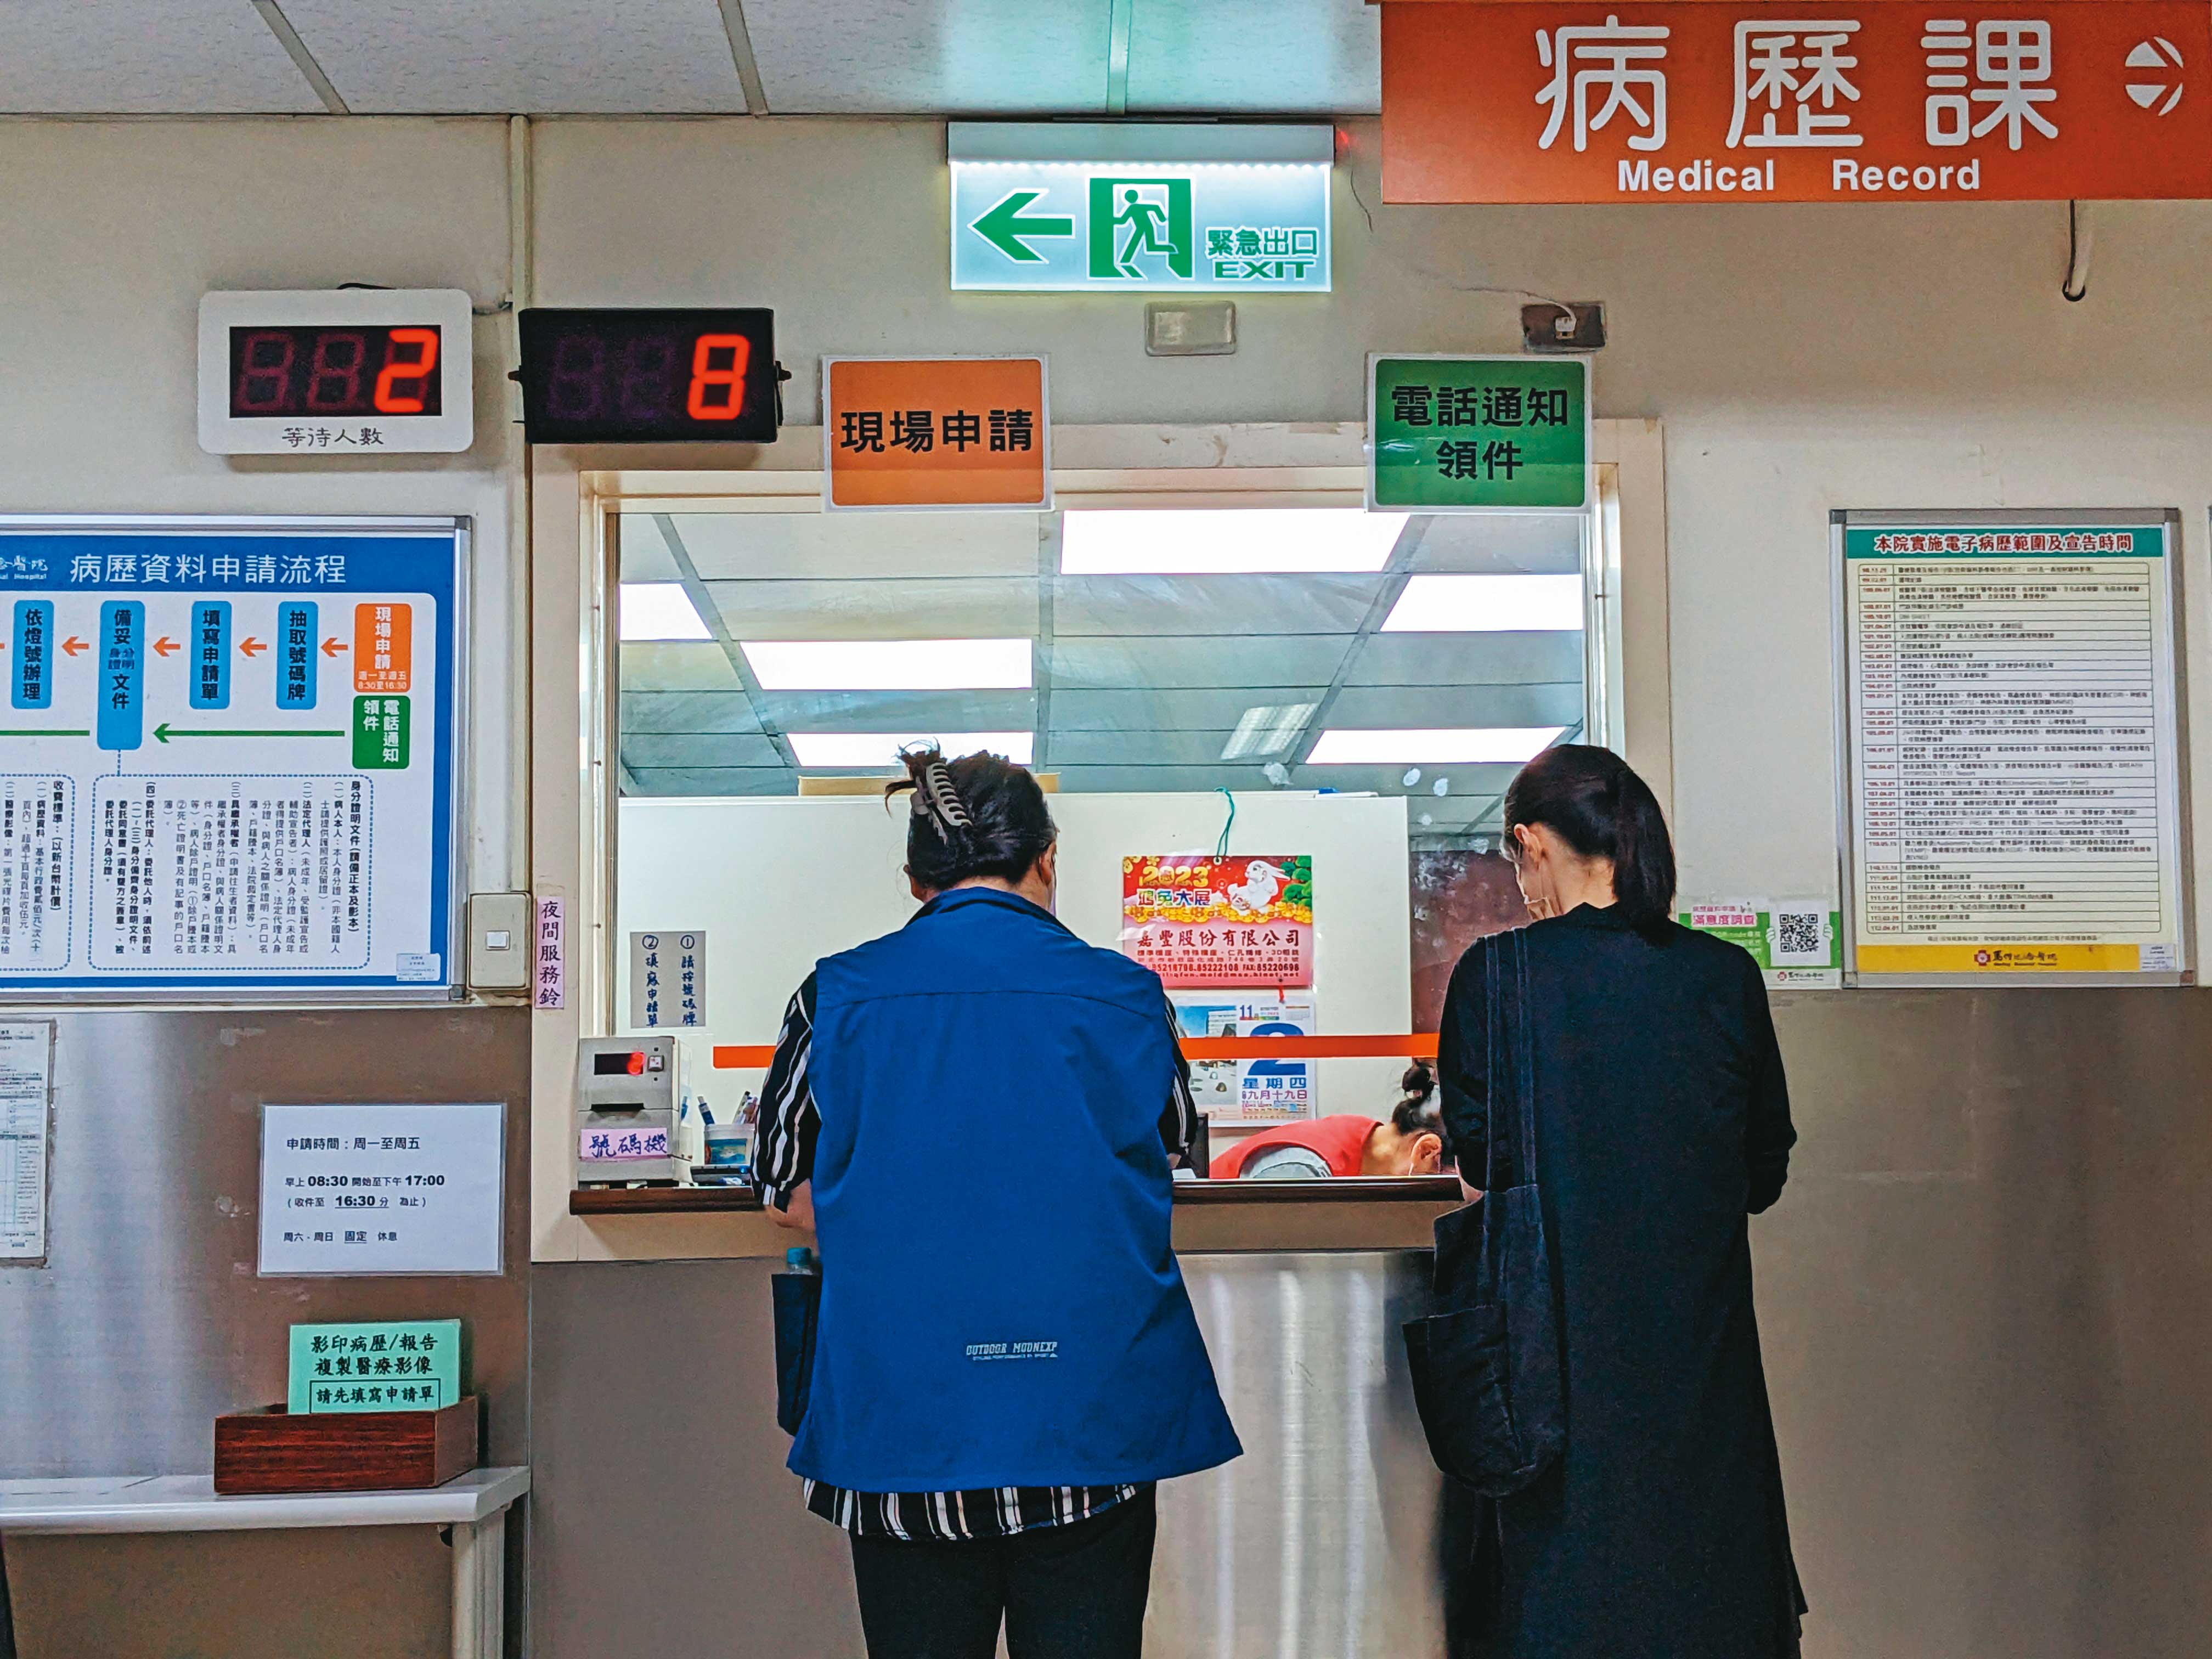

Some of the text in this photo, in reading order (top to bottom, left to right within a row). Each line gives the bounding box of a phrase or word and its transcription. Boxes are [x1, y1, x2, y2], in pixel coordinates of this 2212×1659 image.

[1534, 15, 2059, 151] 病歷課
[1617, 159, 1980, 192] Medical Record
[1208, 229, 1318, 257] 緊急出口
[1215, 261, 1314, 279] EXIT
[374, 329, 438, 413] 2
[686, 333, 751, 420] 8
[1391, 386, 1569, 428] 電話通知
[281, 426, 385, 447] 等待人數
[840, 409, 1034, 454] 現場申請
[1436, 440, 1523, 481] 領件
[1874, 532, 2134, 553] 本院實施電子病歷範圍及宣告時間
[70, 553, 346, 585] 病歷資料申請流程
[114, 609, 132, 645] 備妥
[374, 606, 392, 670] 現場申請
[22, 608, 43, 700] 依燈號辦理
[201, 610, 221, 700] 填寫申請單
[287, 610, 308, 701] 抽取號碼牌
[111, 673, 129, 710] 文件
[363, 699, 380, 731] 領件
[382, 699, 400, 763] 電話通知
[1140, 865, 1210, 887] 2023
[538, 899, 562, 1006] 夜間服務鈴
[1242, 1077, 1307, 1089] 星期四
[589, 1133, 667, 1159] 號碼機
[285, 1175, 445, 1187] 早上 08:30 開始至下午 17:00
[335, 1195, 376, 1207] 16:30
[344, 1231, 368, 1242] 固定
[377, 1231, 398, 1242] 休息
[310, 1333, 439, 1353] 影印病歷/報告
[966, 1343, 1007, 1356] OUTDOOR
[314, 1356, 434, 1377] 複製醫療影像
[315, 1386, 435, 1404] 請先填寫申請單
